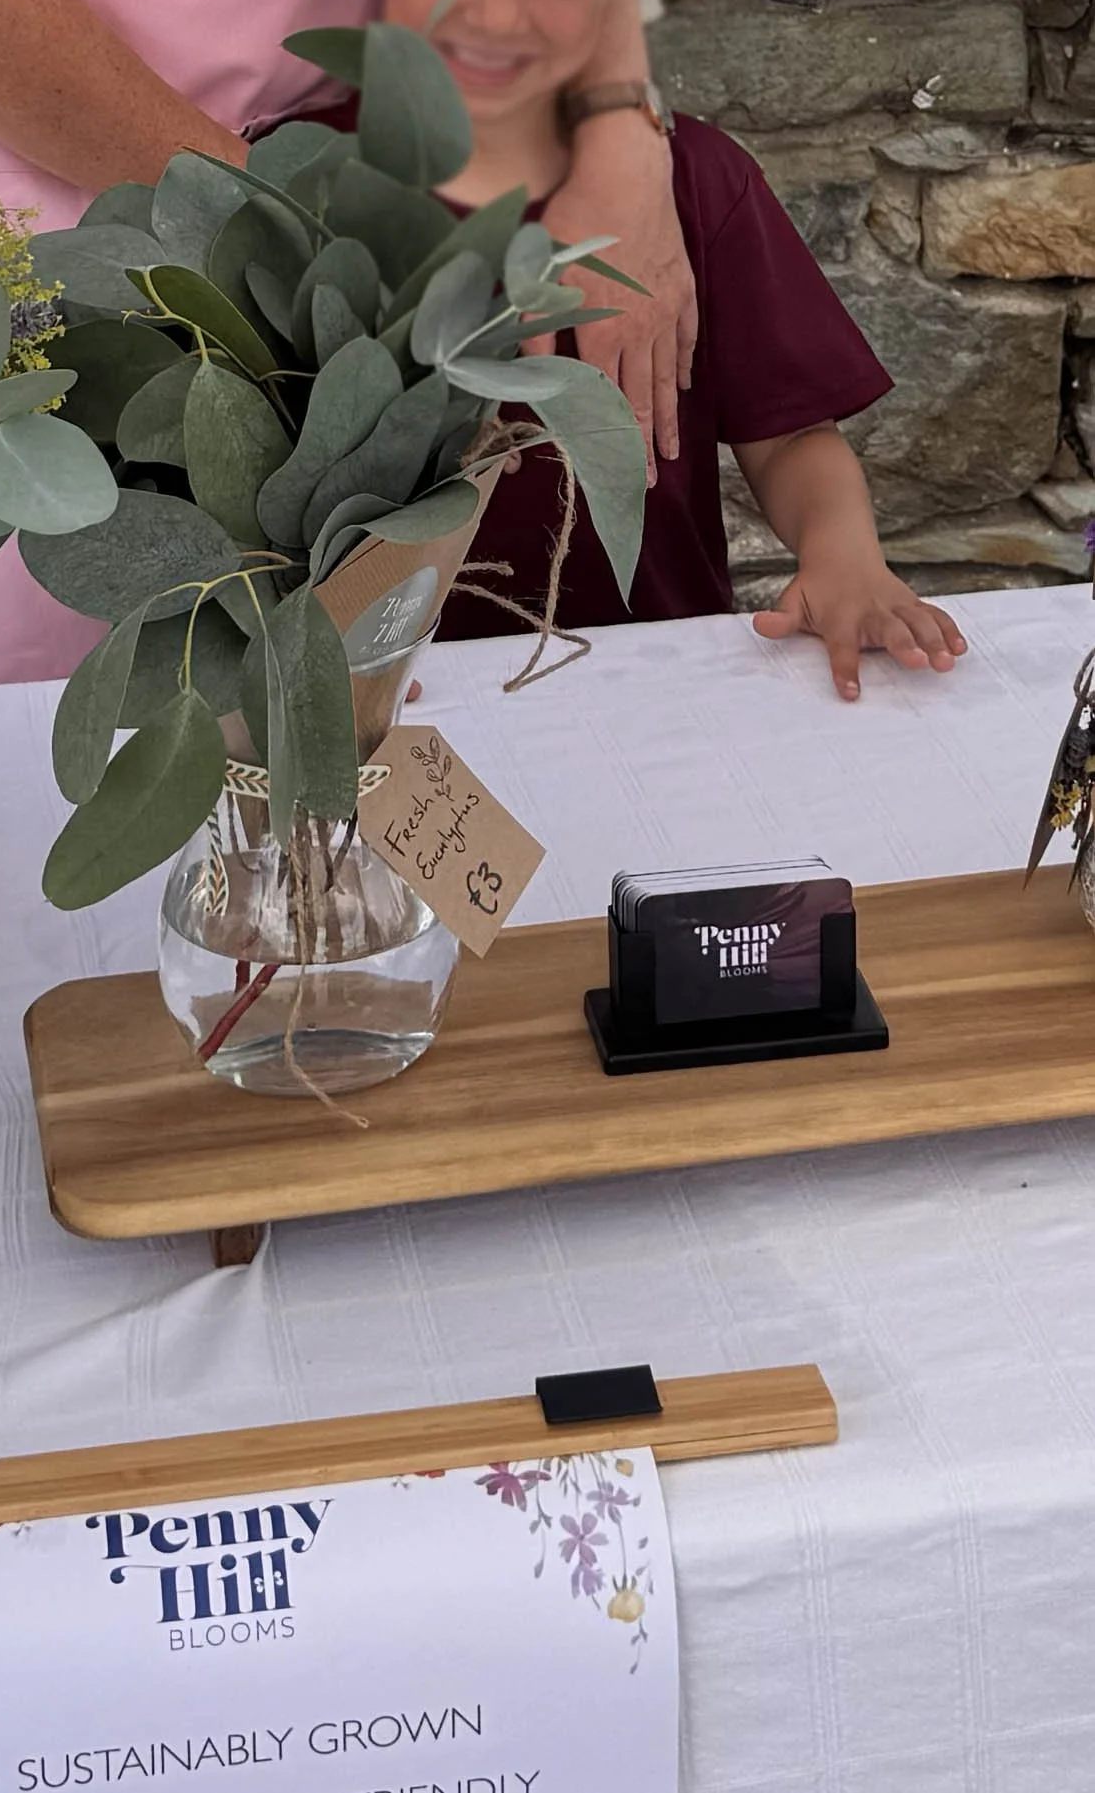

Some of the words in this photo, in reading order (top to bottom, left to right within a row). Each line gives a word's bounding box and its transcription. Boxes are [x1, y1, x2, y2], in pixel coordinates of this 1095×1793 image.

[372, 615, 410, 643] Hill
[383, 794, 435, 857] Fresh
[415, 792, 481, 880] Eucalyptus
[466, 861, 503, 915] €3
[693, 921, 786, 947] Penny
[702, 941, 768, 968] Hill
[718, 965, 768, 979] BLOOMS
[85, 1498, 336, 1560] Penny
[109, 1547, 297, 1624] Hill
[168, 1615, 296, 1651] BLOOMS
[17, 1726, 294, 1793] SUSTAINABLY
[308, 1704, 483, 1755] GROWN
